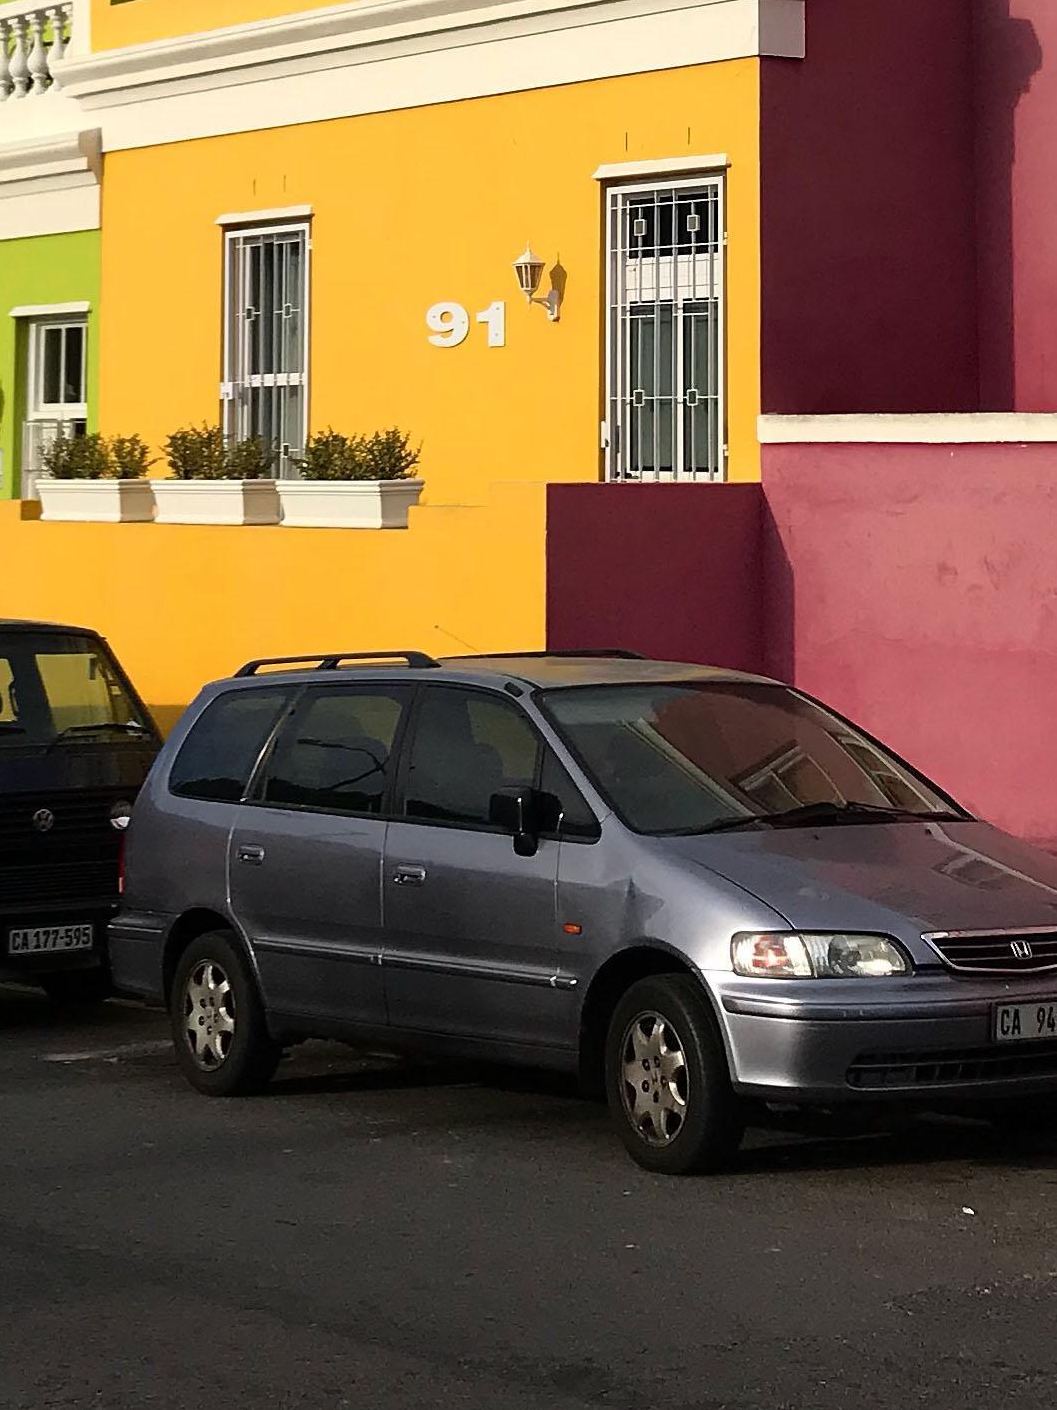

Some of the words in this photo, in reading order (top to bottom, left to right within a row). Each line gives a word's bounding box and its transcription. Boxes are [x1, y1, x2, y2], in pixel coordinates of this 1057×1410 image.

[426, 301, 506, 348] 91
[12, 932, 29, 951] CA
[33, 926, 91, 950] 177-595
[1000, 1008, 1021, 1036] CA
[1036, 1006, 1056, 1033] 94
